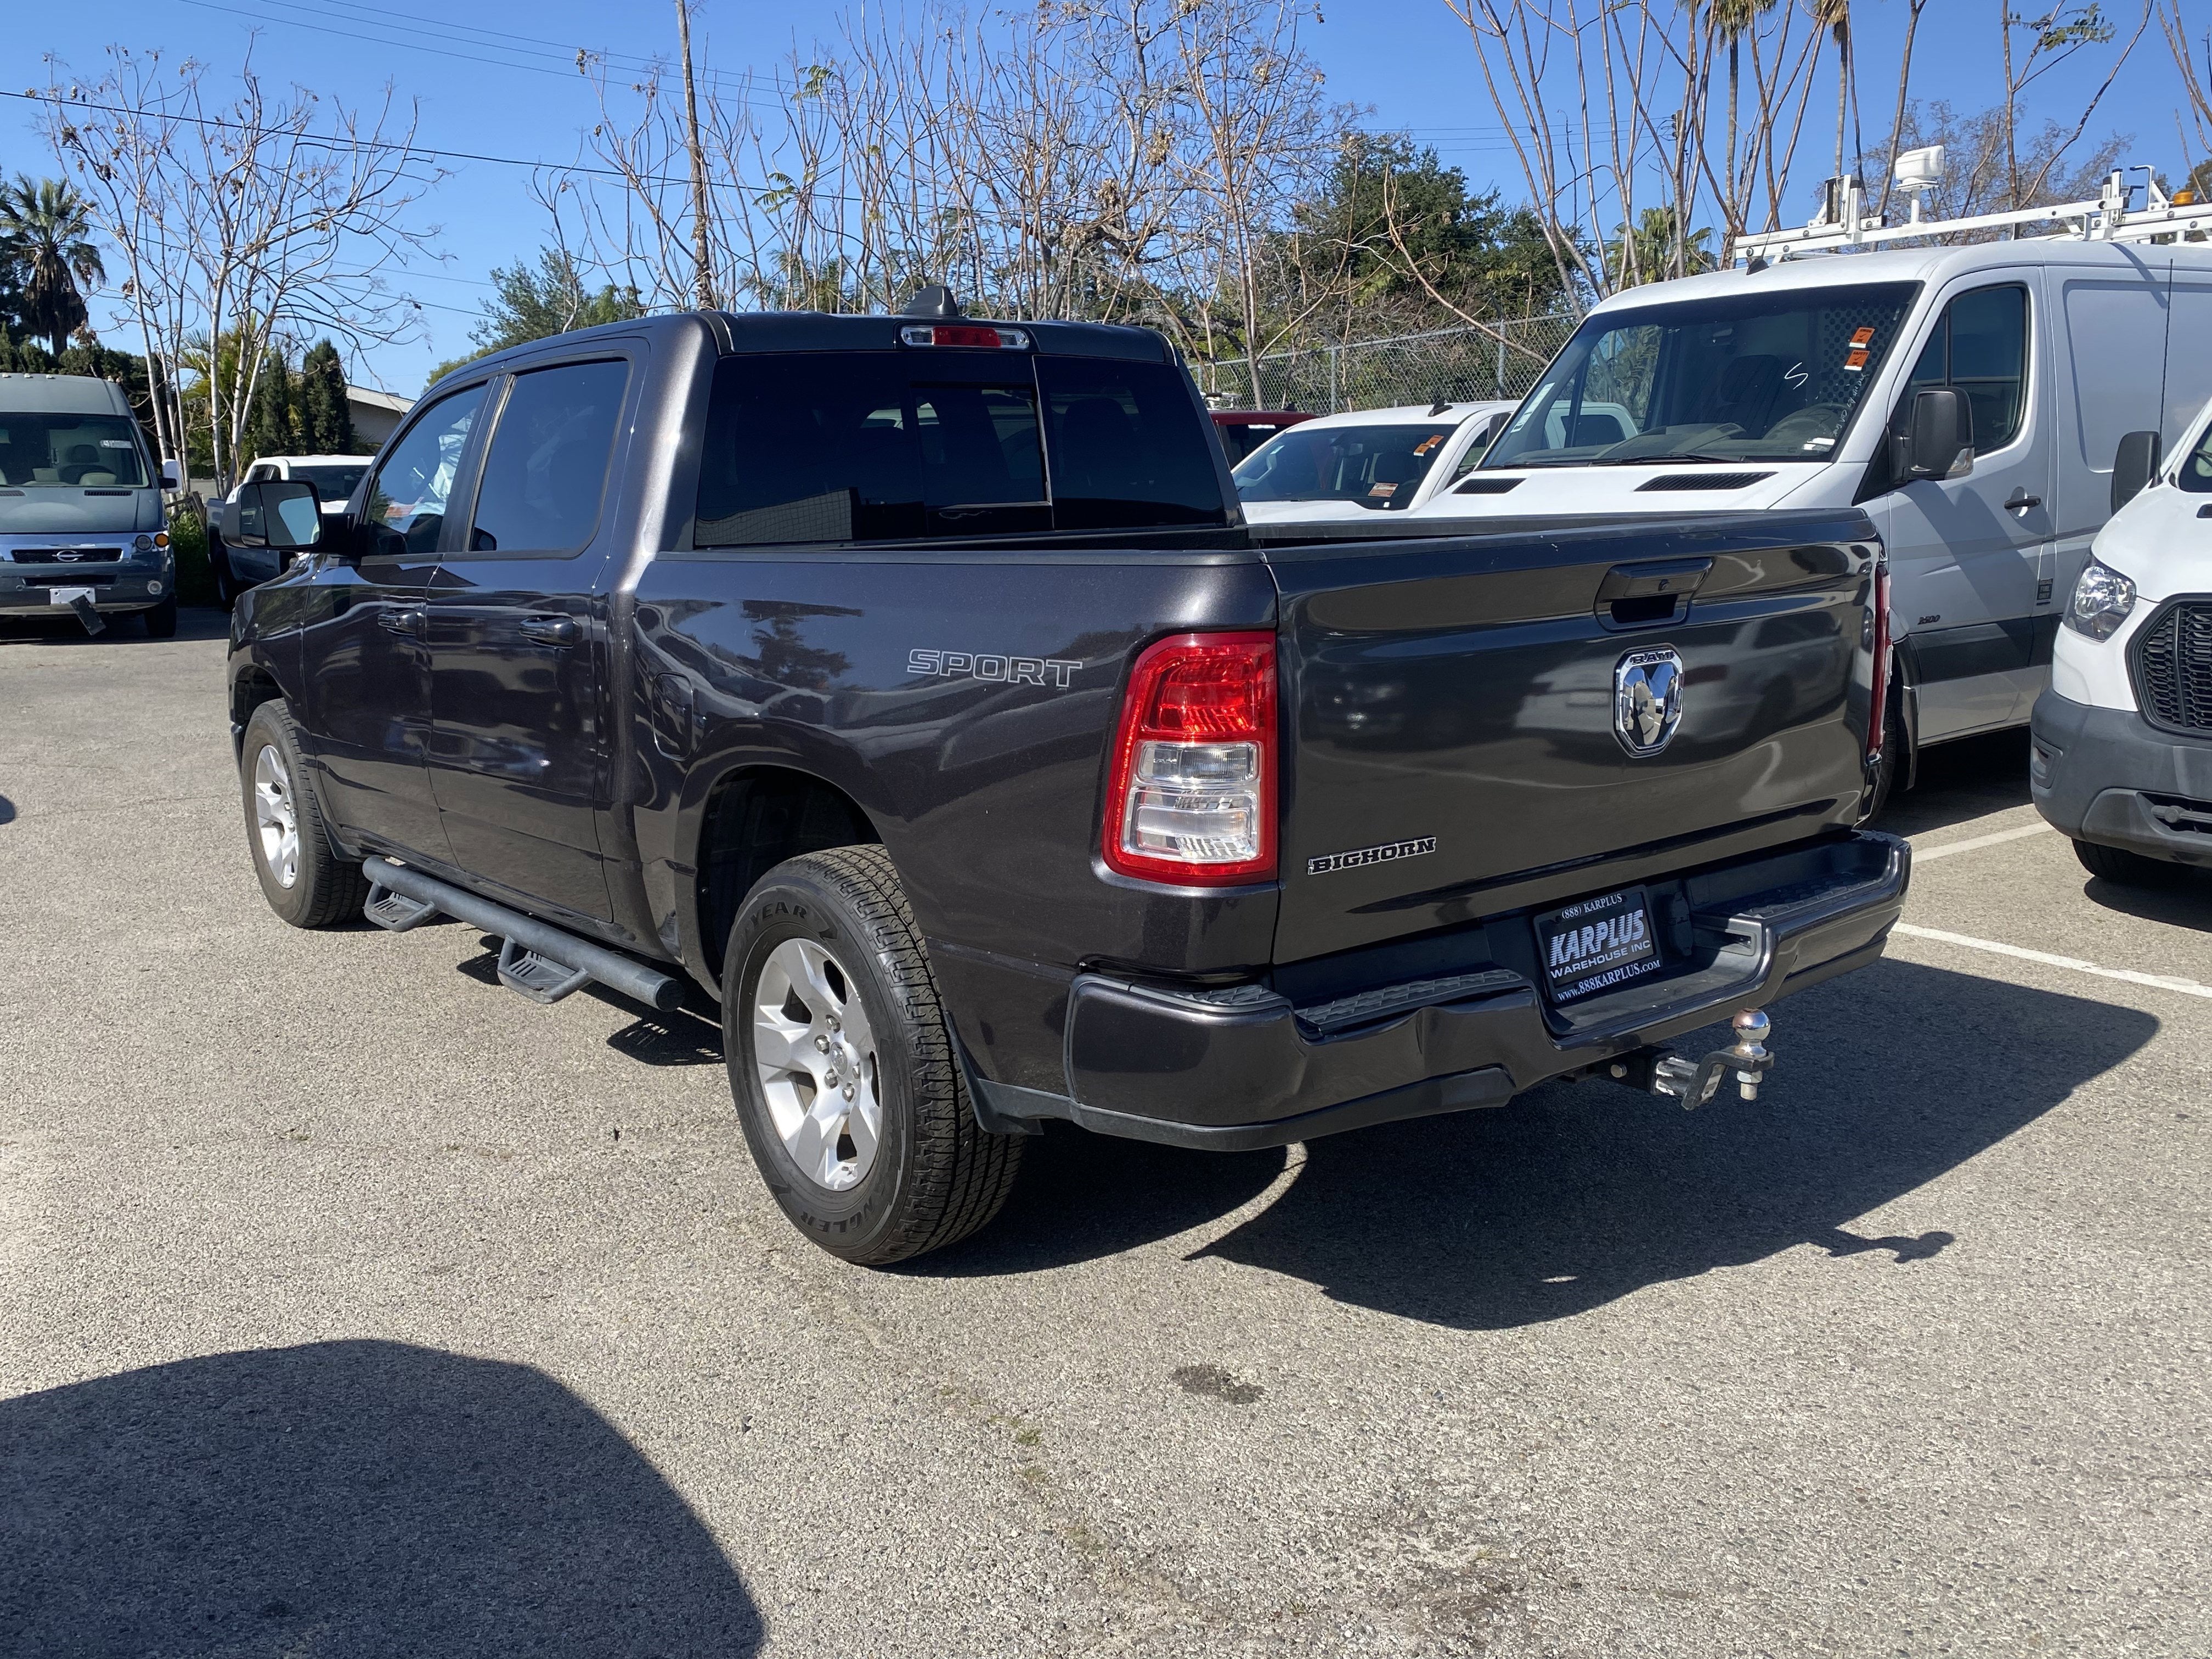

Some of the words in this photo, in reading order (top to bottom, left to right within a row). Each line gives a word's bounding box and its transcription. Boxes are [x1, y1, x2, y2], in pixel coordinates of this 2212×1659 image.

[907, 648, 1083, 687] SPORT
[1629, 650, 1675, 665] RAM
[1561, 906, 1582, 919] (888)
[1584, 893, 1622, 913] KARPLUS
[1549, 909, 1645, 967] KARPLUS
[1550, 947, 1628, 979] WAREHOUSE
[1631, 940, 1651, 953] INC
